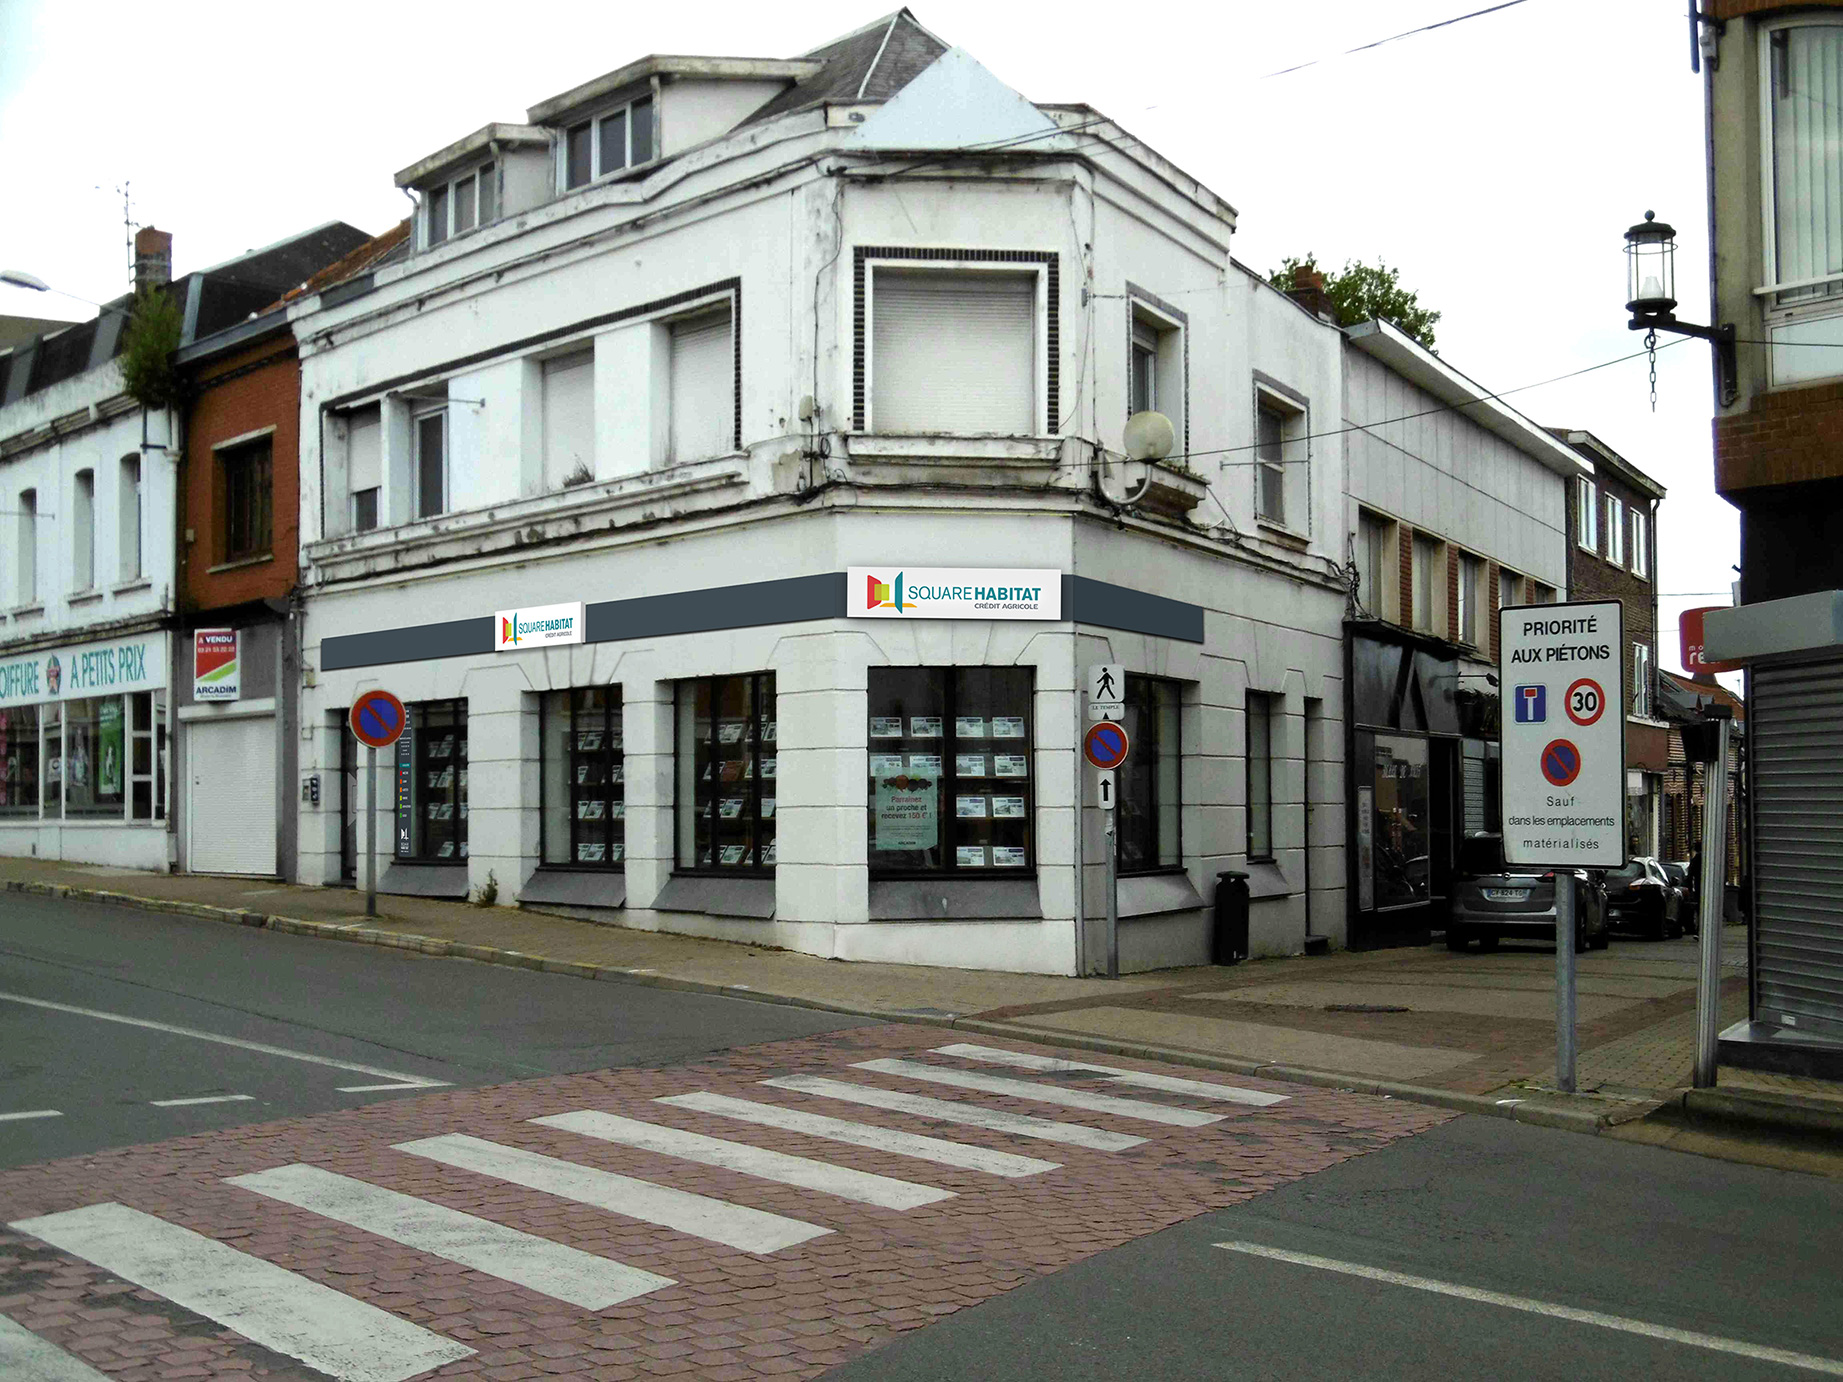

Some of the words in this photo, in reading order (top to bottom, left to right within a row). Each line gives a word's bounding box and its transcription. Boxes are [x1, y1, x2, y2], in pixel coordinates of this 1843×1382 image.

[908, 585, 972, 600] SQUARE
[974, 587, 1041, 601] HABITAT
[974, 602, 1001, 610] CRÉDIT
[518, 620, 545, 634] SQUARE
[545, 618, 573, 631] HABITAT
[1523, 615, 1597, 636] PRIORITÉ
[205, 635, 233, 643] VENDU
[1511, 648, 1542, 663] AUX
[1546, 644, 1610, 662] PIÉTONS
[81, 647, 115, 688] PETITS
[118, 643, 146, 682] PRIX
[1572, 692, 1597, 712] 30
[896, 804, 919, 812] proche
[1546, 796, 1575, 807] Sauf
[1508, 816, 1531, 826] dans
[1532, 816, 1546, 826] les
[1547, 816, 1615, 828] emplacements
[1523, 838, 1599, 849] matérialisés
